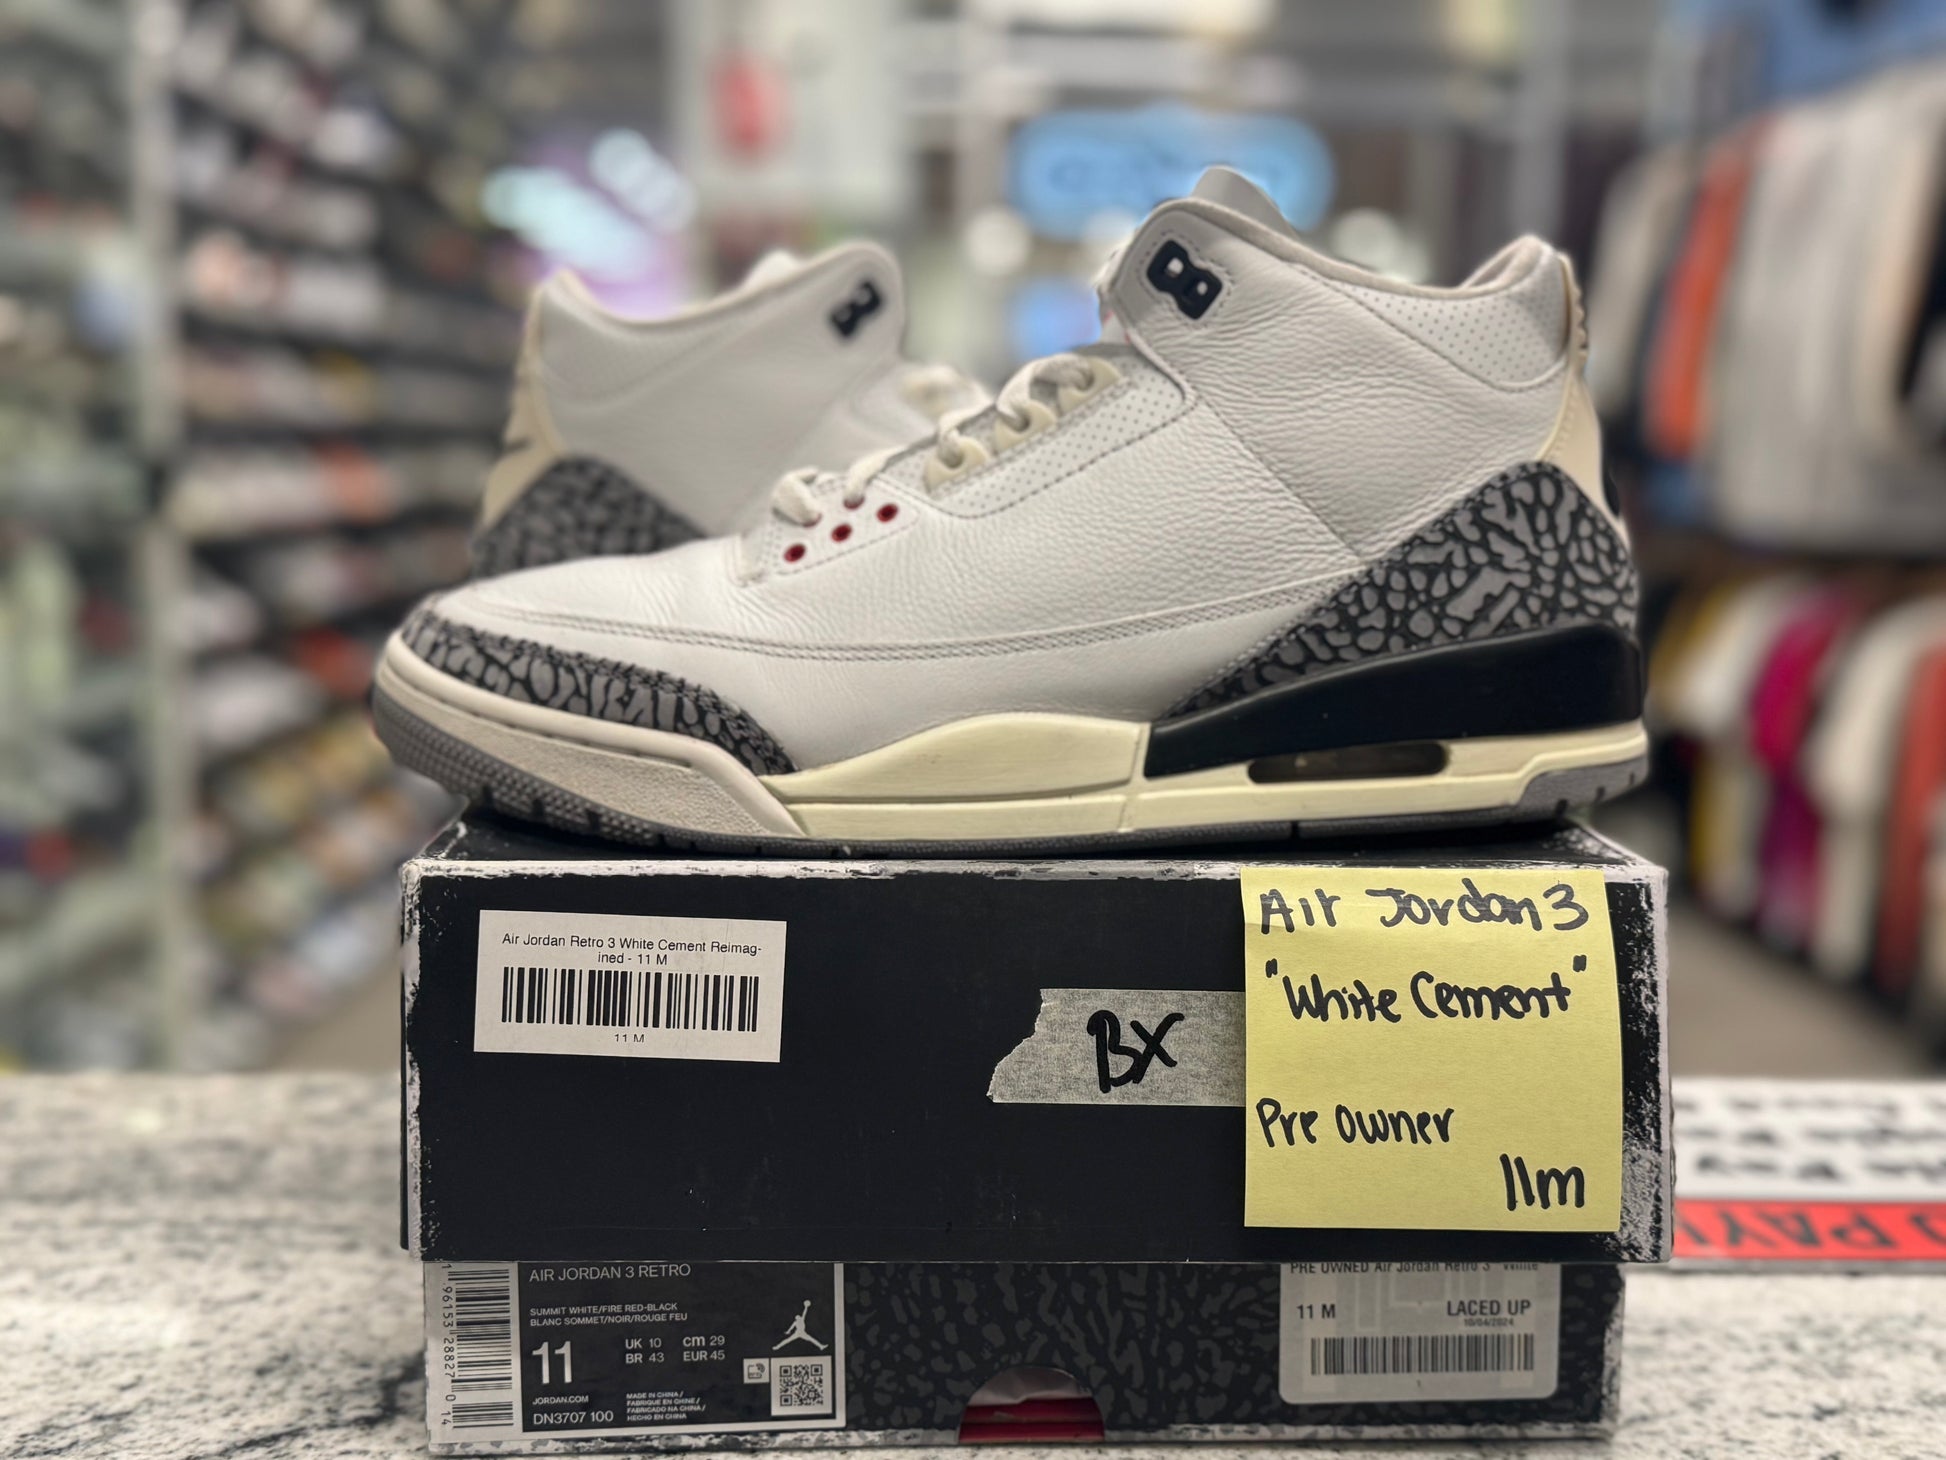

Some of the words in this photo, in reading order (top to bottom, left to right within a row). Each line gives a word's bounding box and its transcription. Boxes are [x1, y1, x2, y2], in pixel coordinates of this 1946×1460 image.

[1365, 878, 1542, 932] Jordan
[1543, 883, 1590, 931] 3
[502, 933, 519, 945] Air
[523, 934, 566, 947] Jordan
[570, 935, 604, 948] Retro
[607, 938, 616, 949] 3
[620, 938, 654, 950] White
[658, 939, 706, 952] Cement
[710, 941, 762, 956] Reimag-
[597, 952, 624, 963] ined
[637, 954, 650, 964] 11
[656, 954, 668, 965] M
[1264, 958, 1401, 1023] "White
[1409, 954, 1588, 1020] Cement"
[614, 1033, 628, 1043] 11
[633, 1033, 645, 1043] M
[1087, 1009, 1185, 1093] BX
[1256, 1097, 1318, 1147] Pre
[529, 1269, 555, 1282] AIR
[558, 1266, 621, 1281] JORDAN
[625, 1266, 635, 1278] 3
[638, 1263, 691, 1278] RETRO
[1321, 1262, 1369, 1273] OWNED
[1374, 1262, 1392, 1272] Air
[1396, 1262, 1439, 1272] Jordan
[442, 1286, 454, 1328] 96153
[530, 1307, 566, 1316] SUMMIT
[569, 1304, 622, 1315] WHITE/FIRE
[624, 1302, 678, 1312] RED-BLACK
[1296, 1304, 1313, 1319] 11
[1321, 1304, 1336, 1319] M
[1447, 1300, 1501, 1316] LACED
[1507, 1300, 1531, 1316] UP
[530, 1317, 562, 1326] BLANC
[564, 1314, 667, 1325] SOMMET/NOIR/ROUGE
[669, 1312, 688, 1321] FEU
[625, 1338, 642, 1349] UK
[649, 1337, 661, 1348] 10
[683, 1336, 705, 1347] cm
[710, 1335, 725, 1346] 29
[443, 1337, 456, 1378] 28827
[532, 1341, 572, 1384] 11
[625, 1353, 643, 1364] BR
[649, 1352, 665, 1362] 43
[683, 1350, 708, 1361] EUR
[710, 1350, 725, 1360] 45
[532, 1395, 589, 1405] JORDAN.COM
[533, 1412, 585, 1425] DN3707
[590, 1411, 614, 1422] 100
